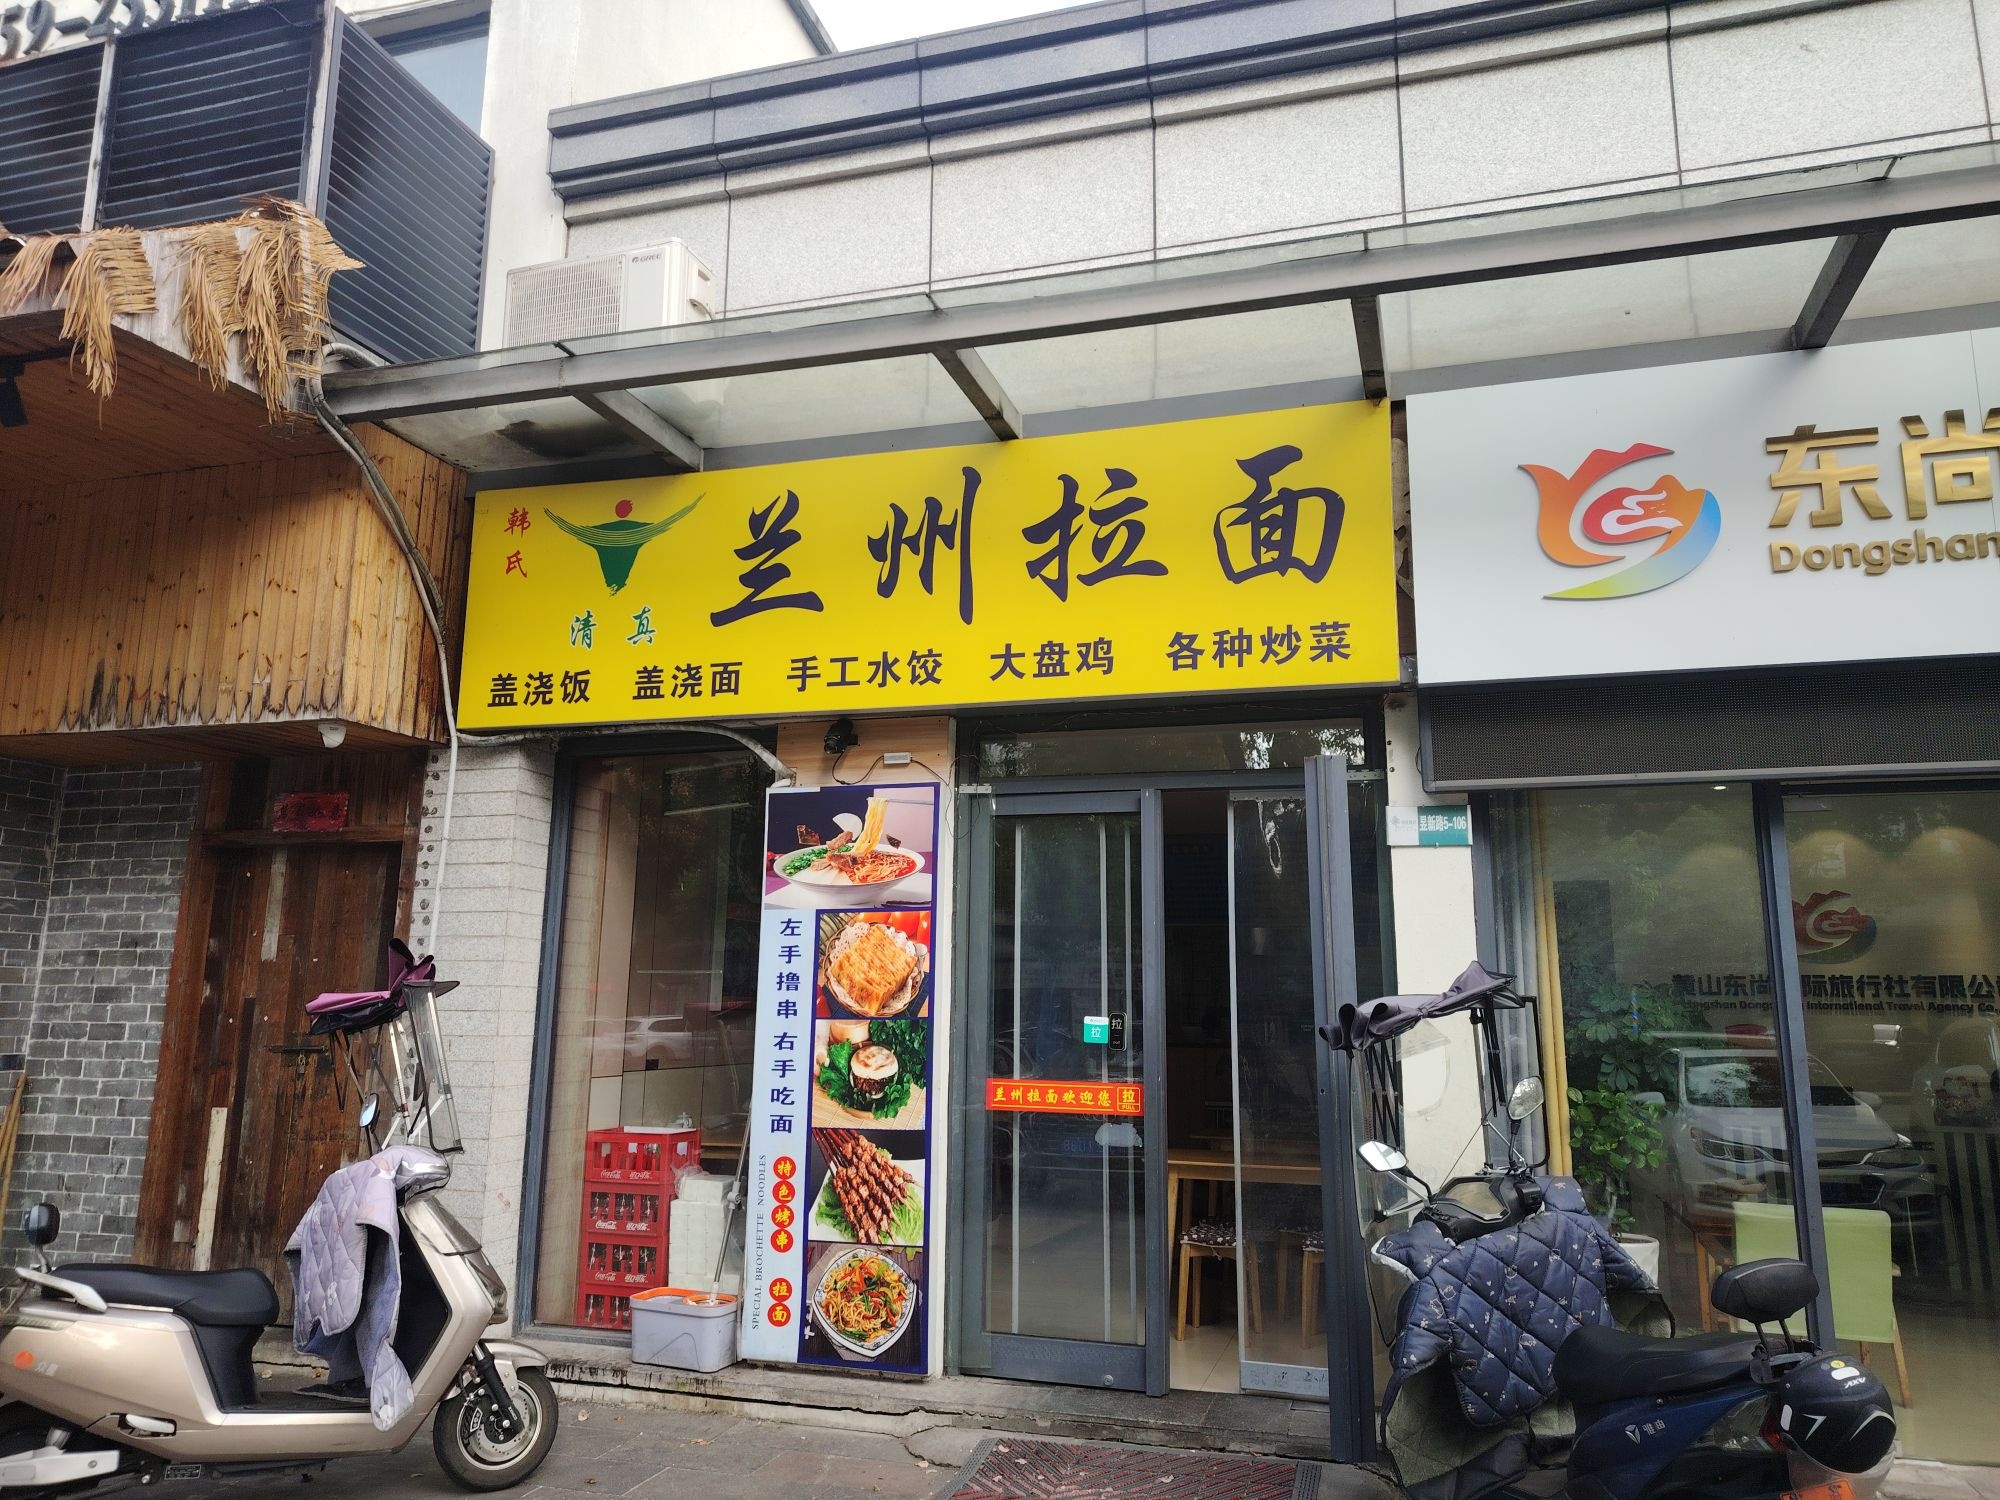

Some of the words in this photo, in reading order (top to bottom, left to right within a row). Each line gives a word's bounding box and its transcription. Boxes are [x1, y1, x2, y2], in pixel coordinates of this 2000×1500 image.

[1765, 408, 2000, 528] 东尚
[503, 507, 532, 578] 韩氏
[710, 445, 1346, 627] 兰州拉面
[1769, 528, 2000, 575] Dongshan
[569, 605, 657, 650] 清真
[487, 669, 591, 708] 盖浇饭
[632, 661, 743, 700] 盖浇面
[786, 648, 943, 692] 手工水饺
[989, 637, 1115, 682] 大盘鸡
[1166, 621, 1351, 671] 各种炒菜
[1111, 1018, 1123, 1030] 拉
[1886, 1001, 1925, 1011] Travel
[1927, 1002, 1974, 1014] Agency
[1090, 1026, 1102, 1038] 拉
[770, 1032, 798, 1134] 右手吃面
[993, 1086, 1112, 1107] 兰州拉面欢迎您
[1122, 1089, 1136, 1103] 拉
[758, 1154, 767, 1206] NOODLES
[755, 1213, 764, 1281] BROCHETTE
[752, 1285, 762, 1330] SPECIAL
